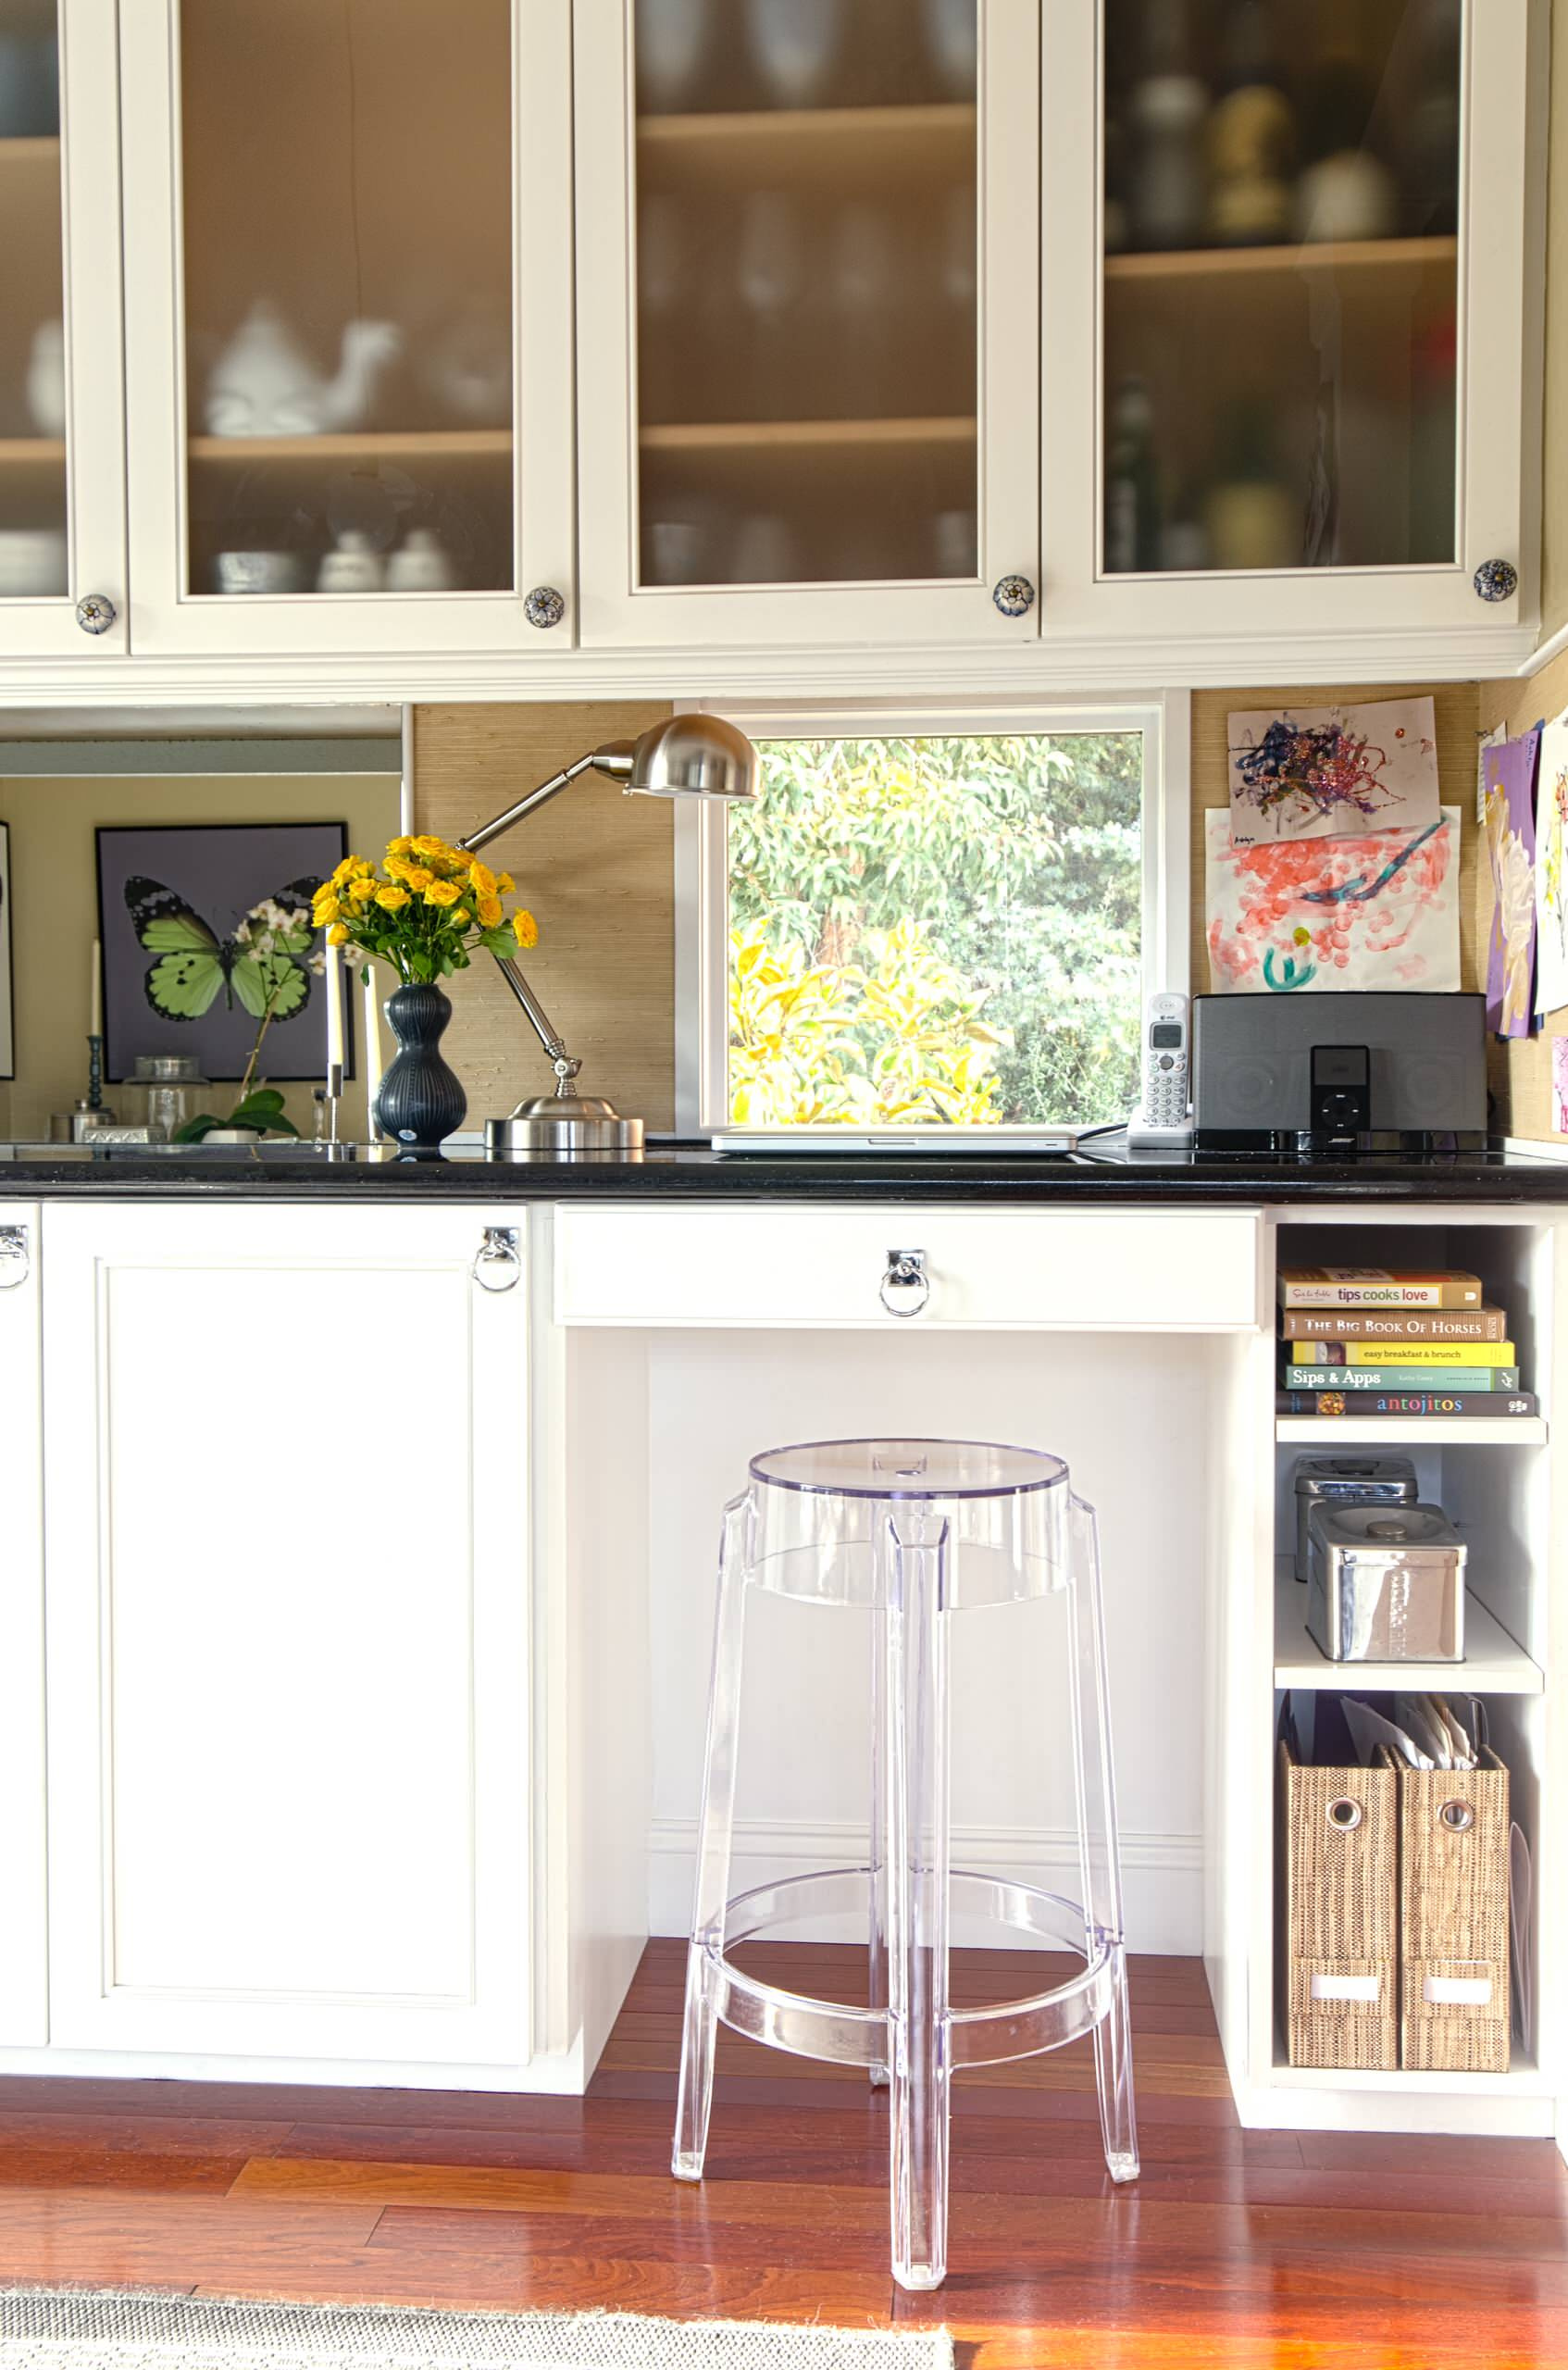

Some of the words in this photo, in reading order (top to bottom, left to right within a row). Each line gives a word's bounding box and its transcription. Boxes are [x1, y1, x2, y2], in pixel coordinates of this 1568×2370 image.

[1338, 1288, 1361, 1303] tips
[1363, 1288, 1400, 1301] cooks
[1402, 1289, 1428, 1301] love
[1304, 1319, 1332, 1331] THE
[1337, 1320, 1360, 1332] BIG
[1365, 1320, 1402, 1333] BOOK
[1432, 1321, 1482, 1334] HORSES
[1363, 1351, 1382, 1359] easy
[1384, 1350, 1422, 1358] breakfast
[1431, 1351, 1462, 1359] brunch
[1293, 1370, 1325, 1388] Sips
[1329, 1372, 1338, 1384] &
[1342, 1370, 1381, 1388] Apps
[1376, 1395, 1462, 1415] antojitos
